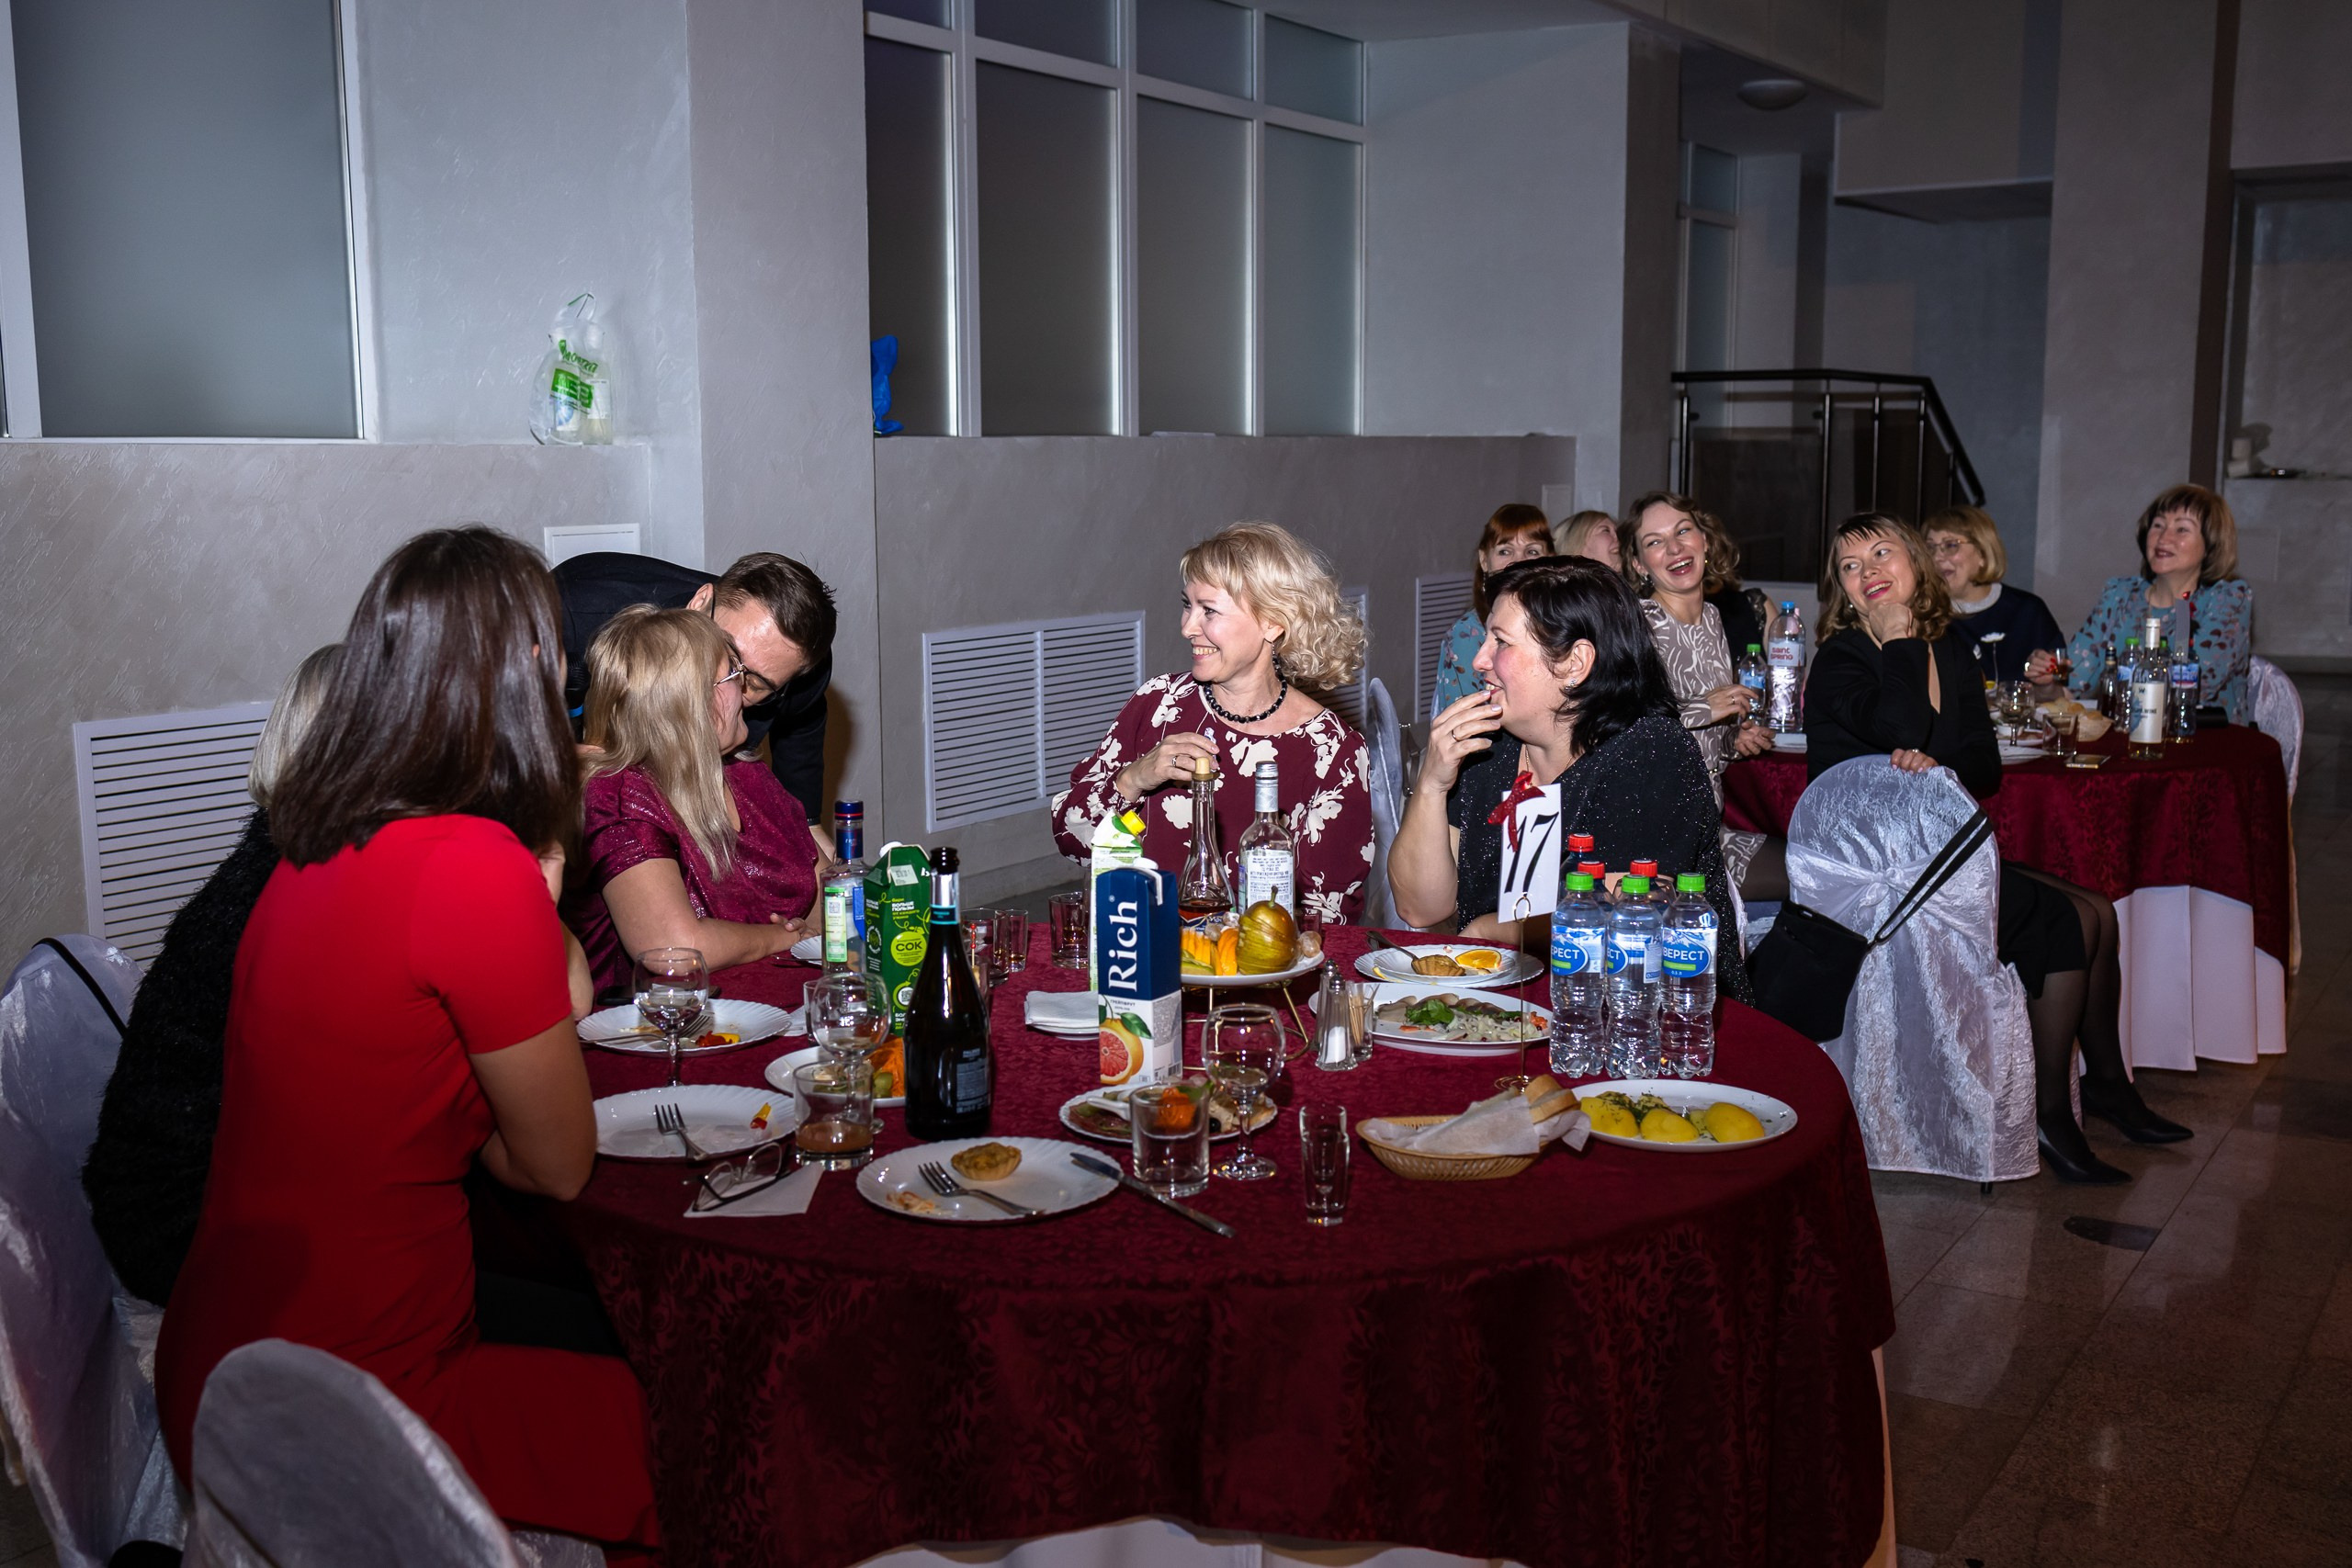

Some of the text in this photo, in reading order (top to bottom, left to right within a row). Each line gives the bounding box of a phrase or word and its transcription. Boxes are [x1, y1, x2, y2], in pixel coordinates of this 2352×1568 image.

[1504, 812, 1560, 897] 17
[895, 941, 922, 952] СОК
[1108, 900, 1137, 992] Rich
